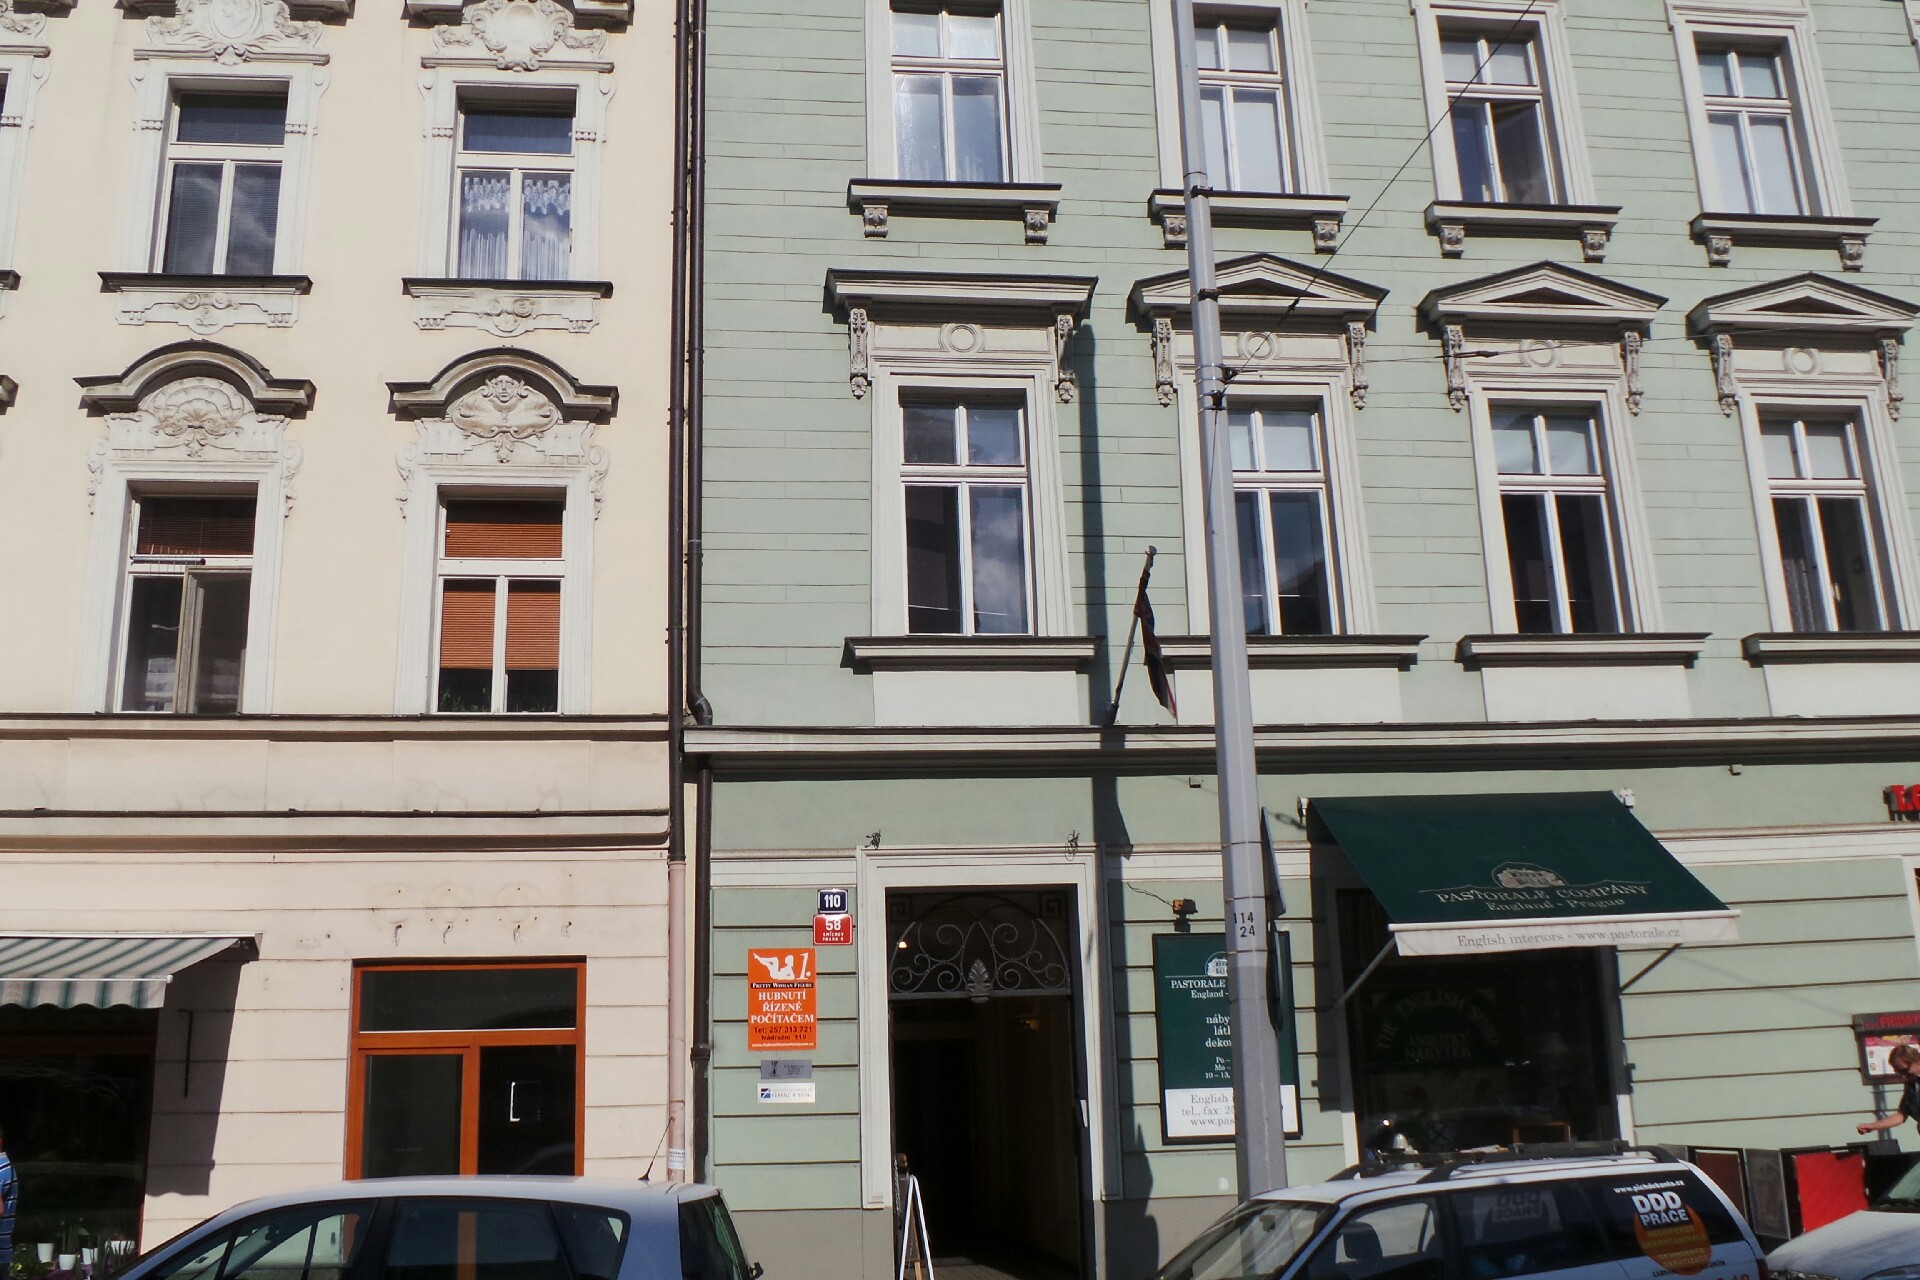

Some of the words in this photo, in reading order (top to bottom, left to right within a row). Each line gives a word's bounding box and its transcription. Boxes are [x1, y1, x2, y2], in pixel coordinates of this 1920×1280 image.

[1435, 889, 1550, 903] PASTORALE
[1556, 884, 1649, 899] COMPANY
[824, 894, 841, 908] 110
[1485, 900, 1555, 911] England
[1565, 898, 1626, 909] Prague
[825, 917, 841, 931] 58
[1239, 925, 1255, 938] 24
[1457, 932, 1507, 947] English
[1508, 931, 1564, 945] interiors
[1576, 926, 1681, 941] www.pastorale.cz
[1171, 979, 1226, 989] PASTORALE
[758, 989, 806, 1000] HUBNUTÍ
[1190, 989, 1224, 1000] England
[762, 1001, 803, 1012] ŘÍZENÉ
[750, 1013, 814, 1024] POČÍTAČEM
[1205, 1013, 1230, 1026] náby
[769, 1026, 782, 1034] 257
[1190, 1093, 1229, 1105] English
[1203, 1105, 1222, 1116] fax:
[1190, 1117, 1235, 1127] www.pas
[1631, 1191, 1682, 1213] DDD
